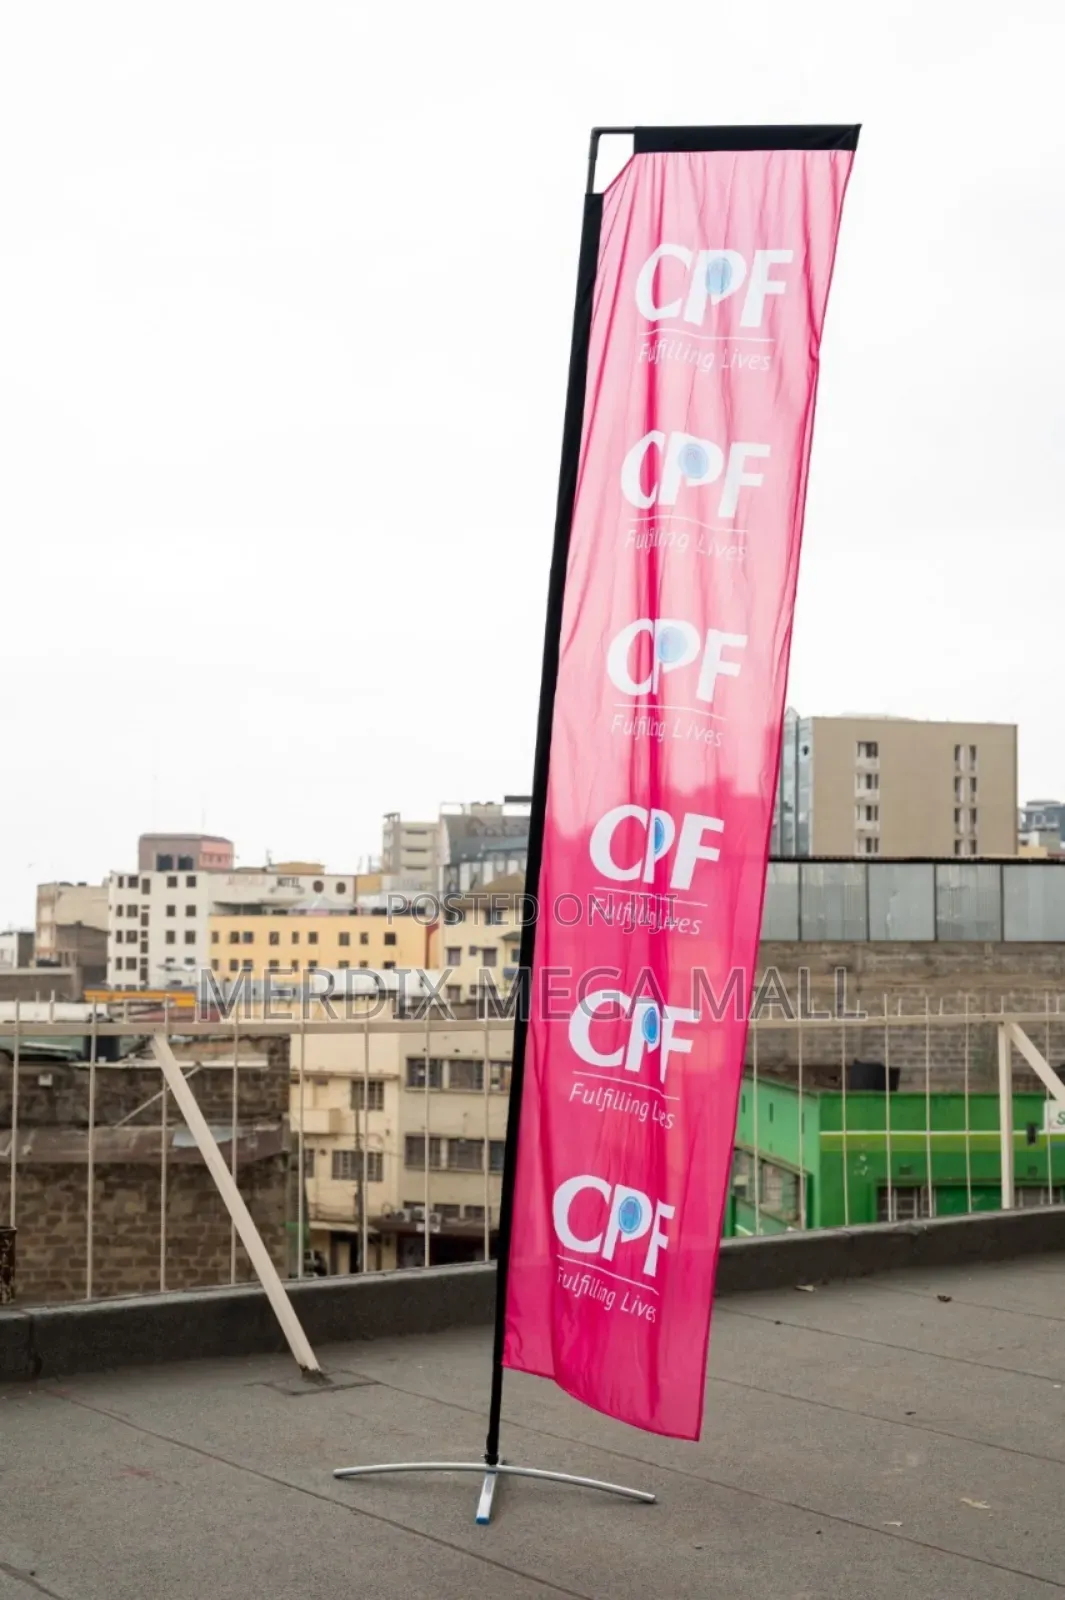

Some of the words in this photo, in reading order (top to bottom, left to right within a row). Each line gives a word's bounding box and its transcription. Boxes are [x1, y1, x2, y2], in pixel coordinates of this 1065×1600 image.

[635, 243, 793, 327] CPF
[621, 430, 771, 518] CPF
[607, 618, 748, 703] CPF
[672, 718, 725, 747] Lives
[589, 804, 725, 890] CPF
[569, 989, 702, 1084] CPF
[569, 1083, 649, 1122] Fulfilling
[552, 1175, 676, 1277] CPF
[557, 1266, 616, 1311] Fulfilling
